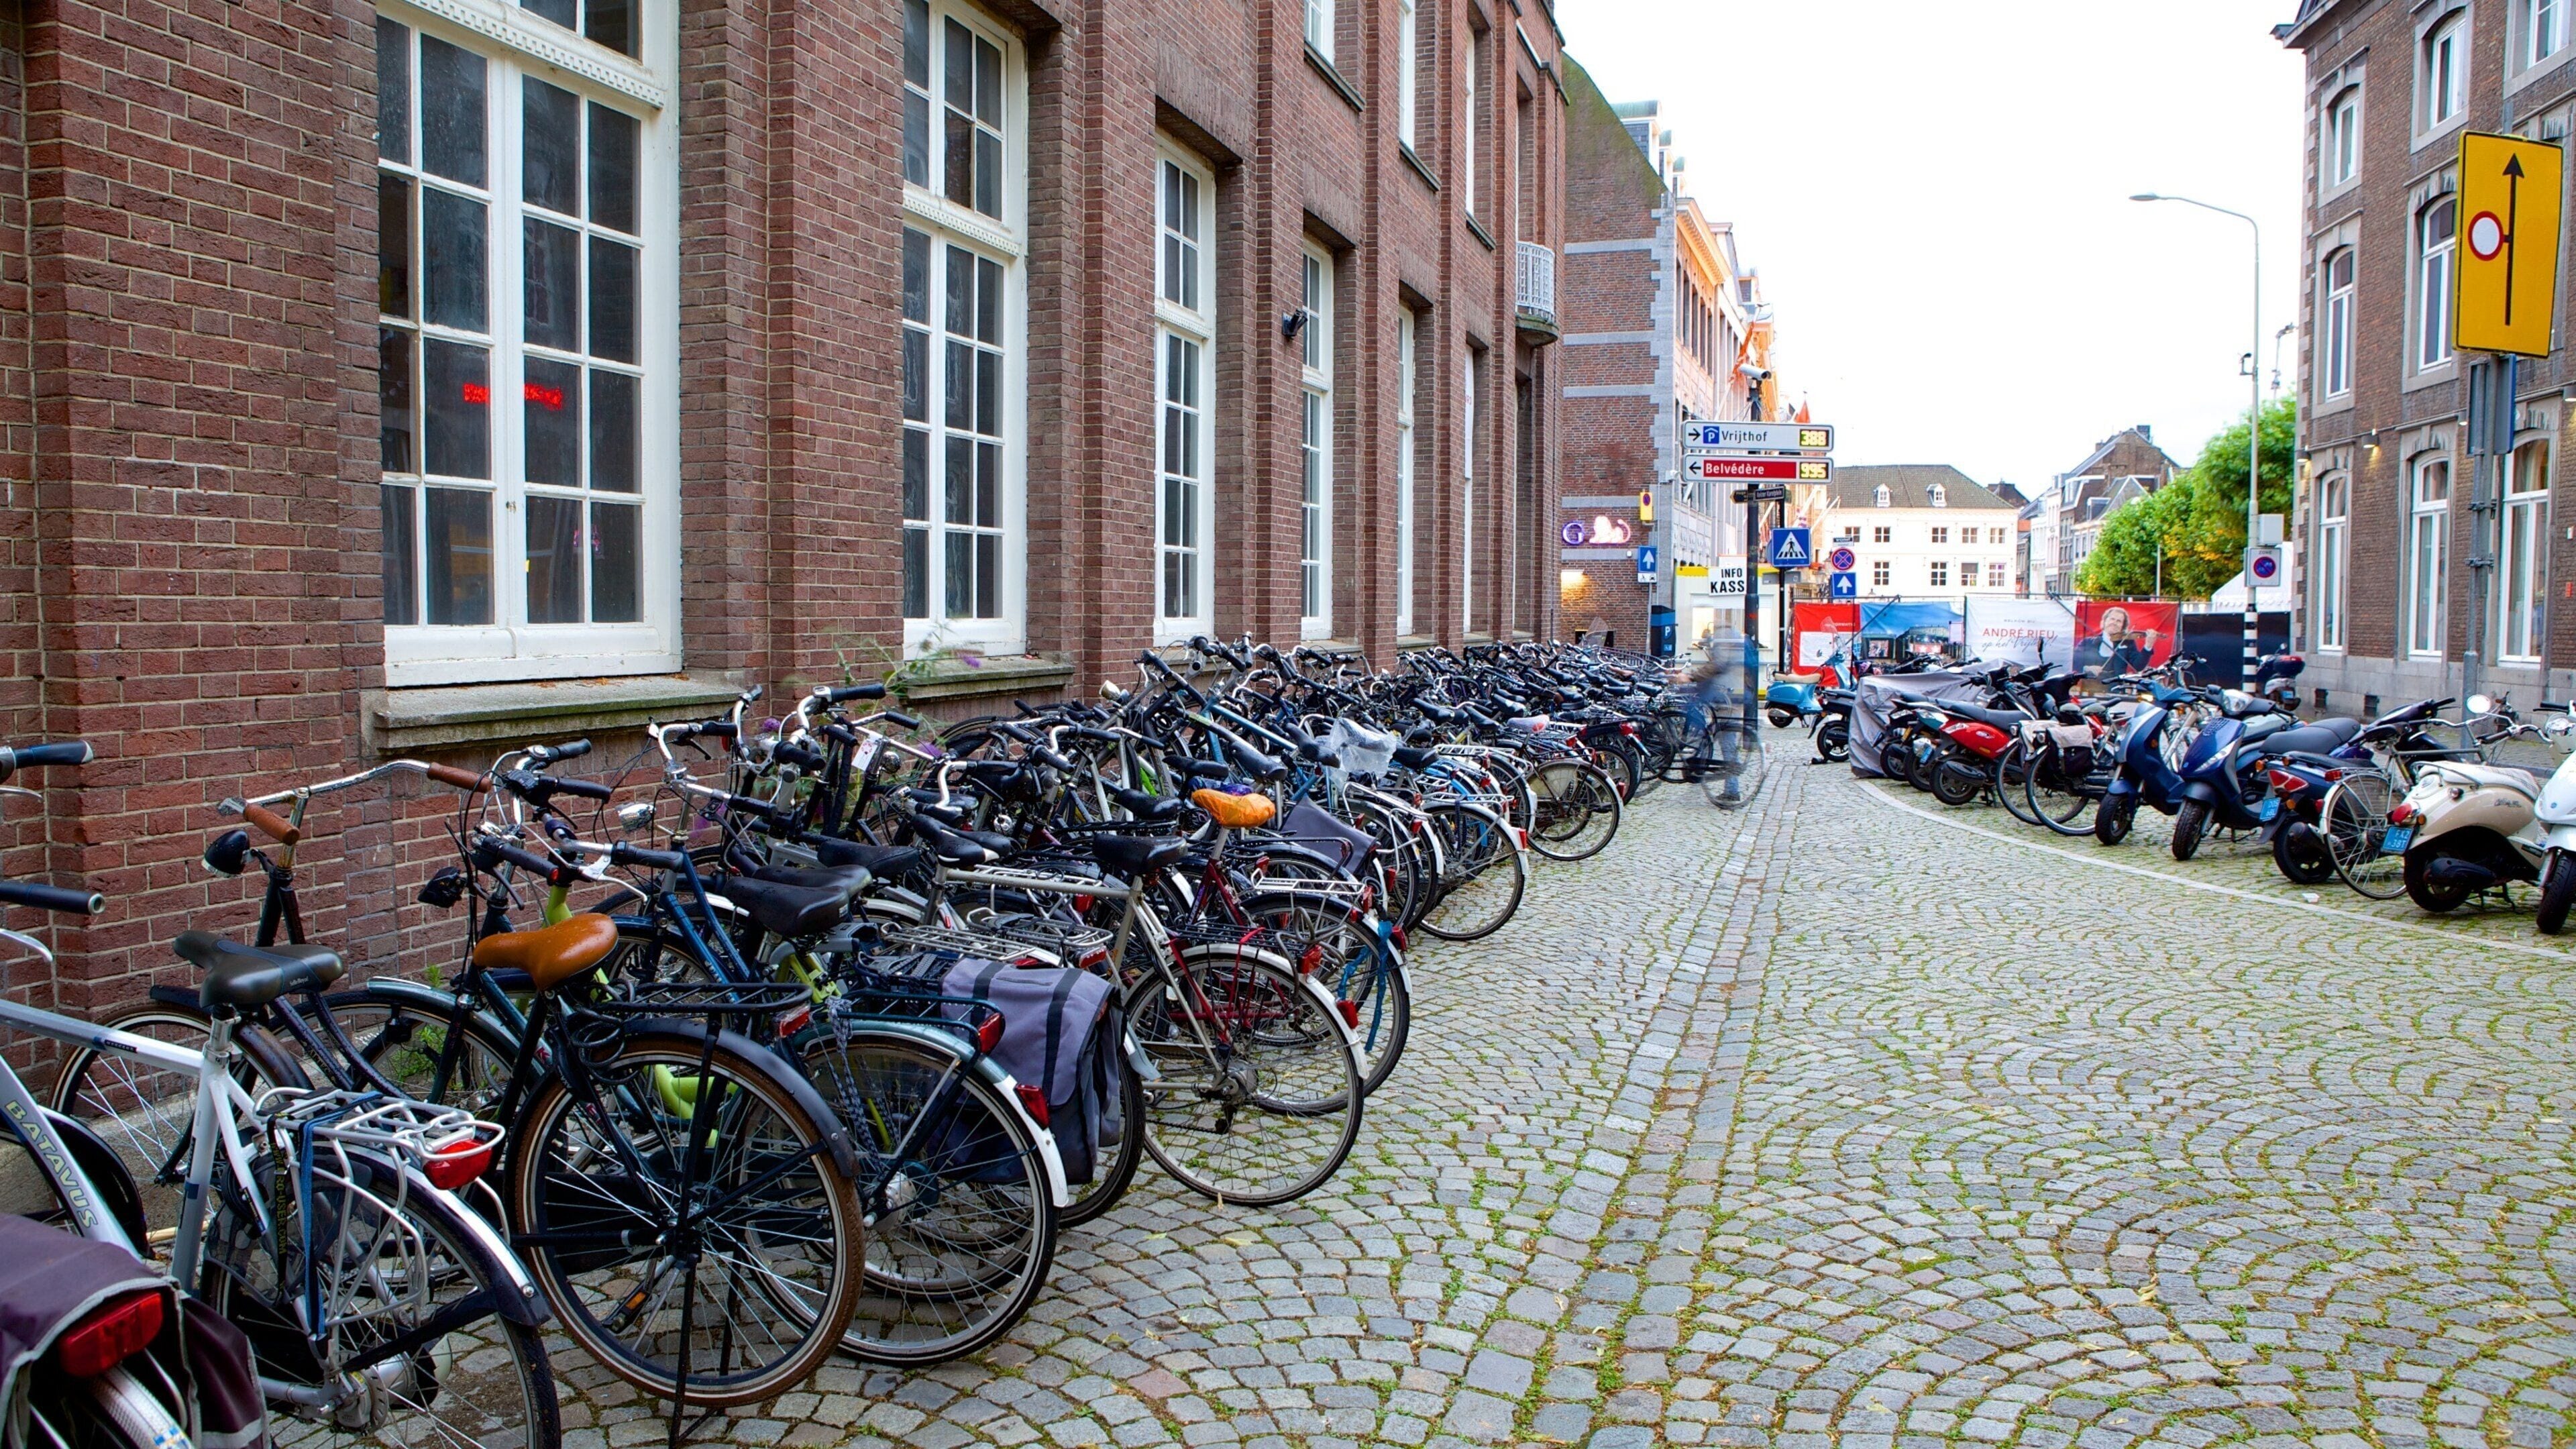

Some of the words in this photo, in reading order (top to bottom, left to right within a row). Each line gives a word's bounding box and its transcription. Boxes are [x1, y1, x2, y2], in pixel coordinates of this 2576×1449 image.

[1721, 430, 1768, 443] Vrijthof
[1801, 429, 1827, 446] 388
[1705, 463, 1764, 475] Belvédère
[1801, 462, 1827, 478] 995
[1721, 568, 1742, 578] INFO
[1982, 627, 2024, 637] ANDRÉ
[2027, 629, 2055, 639] RIEU
[5, 1100, 98, 1228] BATAVUS
